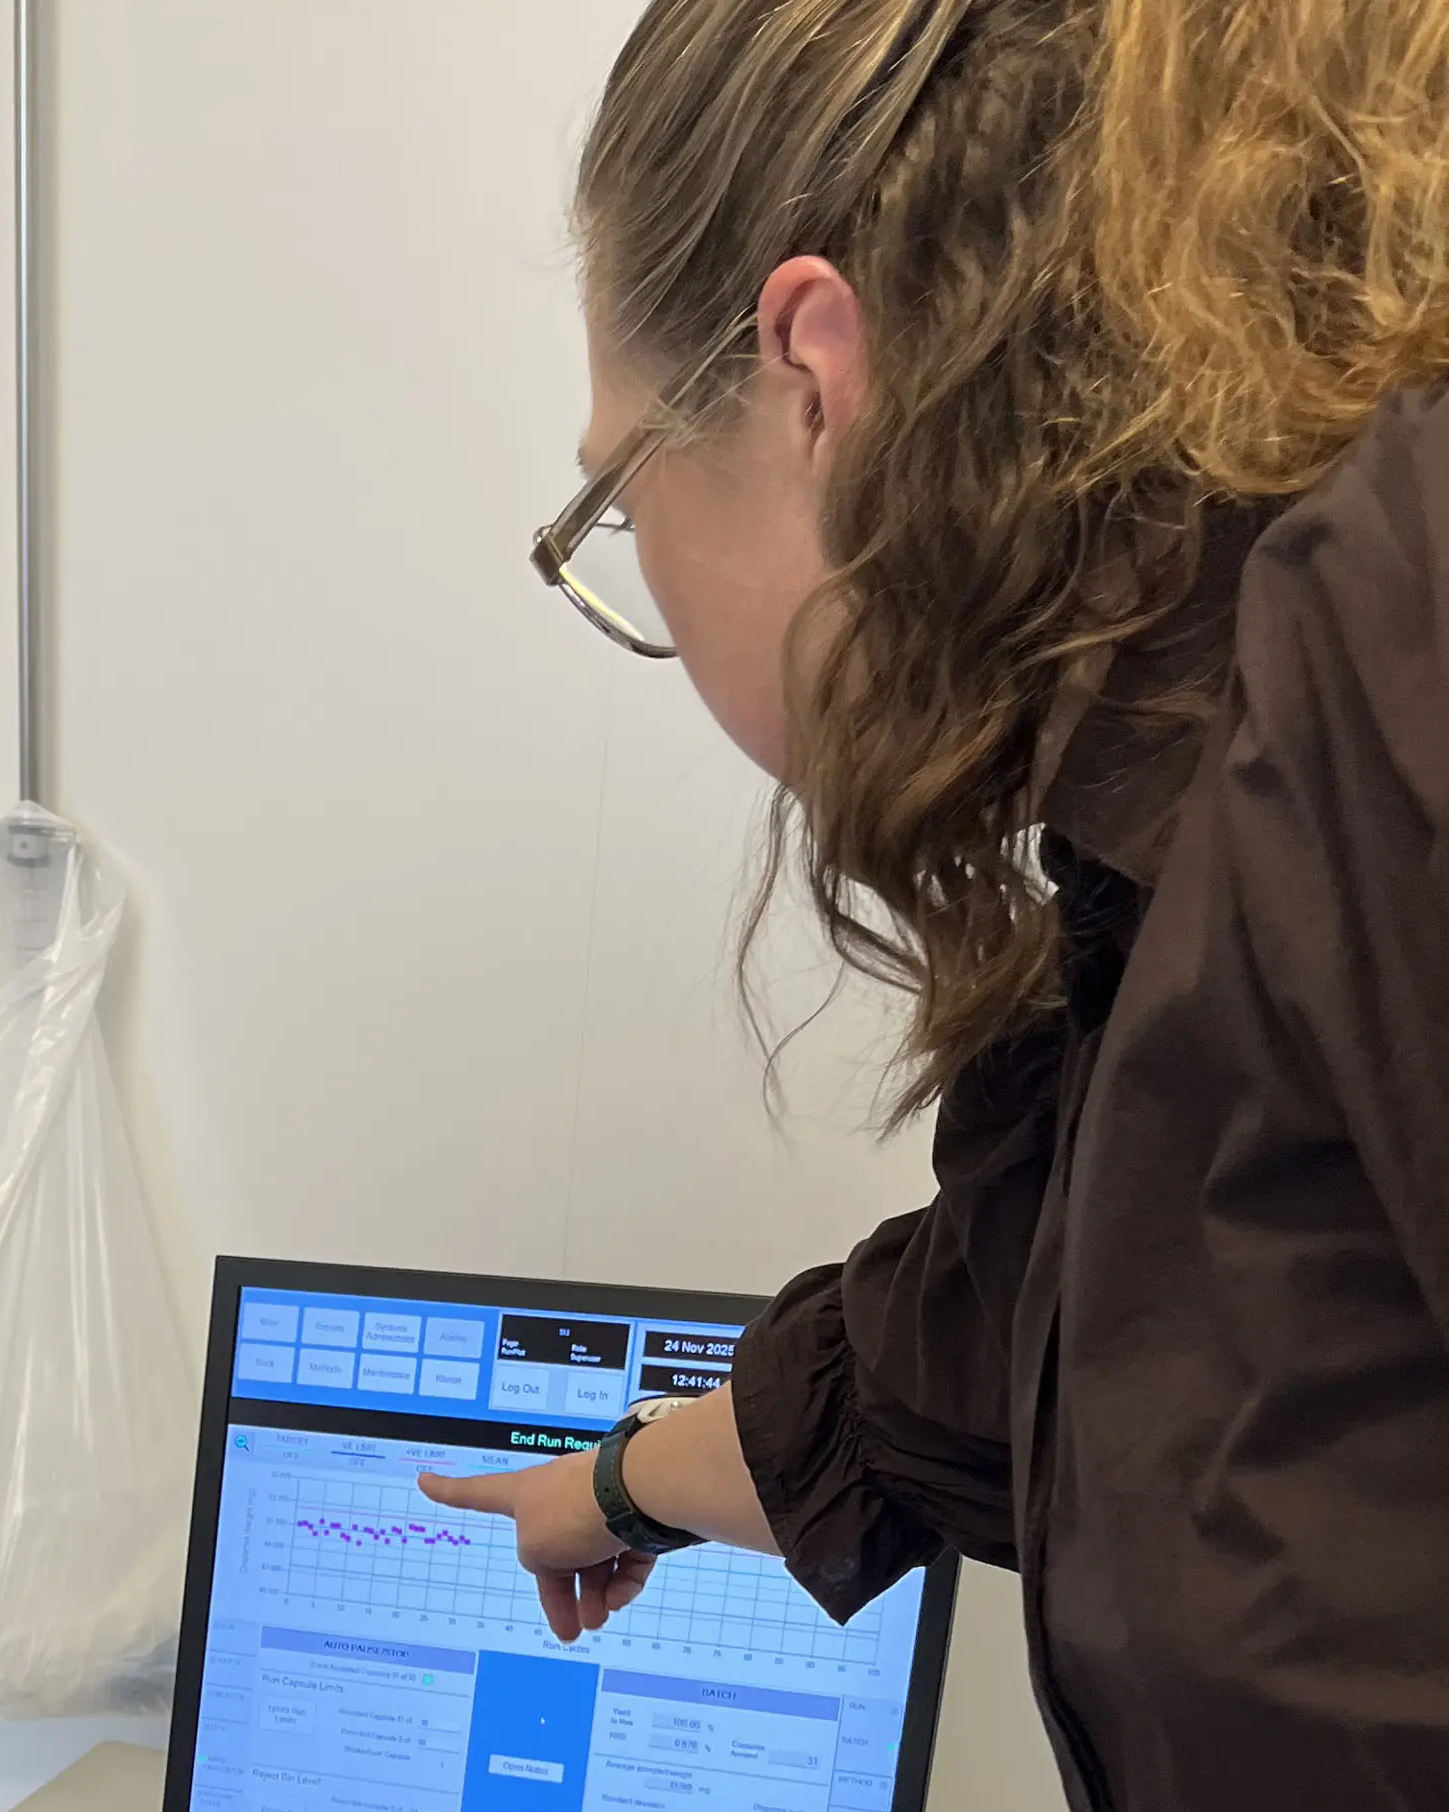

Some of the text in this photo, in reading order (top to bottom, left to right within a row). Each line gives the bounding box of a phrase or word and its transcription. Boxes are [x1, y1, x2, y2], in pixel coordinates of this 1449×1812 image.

[664, 1339, 736, 1357] 24 Nov 2025
[672, 1374, 721, 1389] 12:41:44
[502, 1382, 540, 1395] Log Out
[577, 1388, 609, 1401] Log In
[511, 1432, 602, 1452] End Run Requi
[323, 1640, 350, 1651] AUTO
[543, 1640, 561, 1651] Run
[262, 1673, 280, 1684] Run
